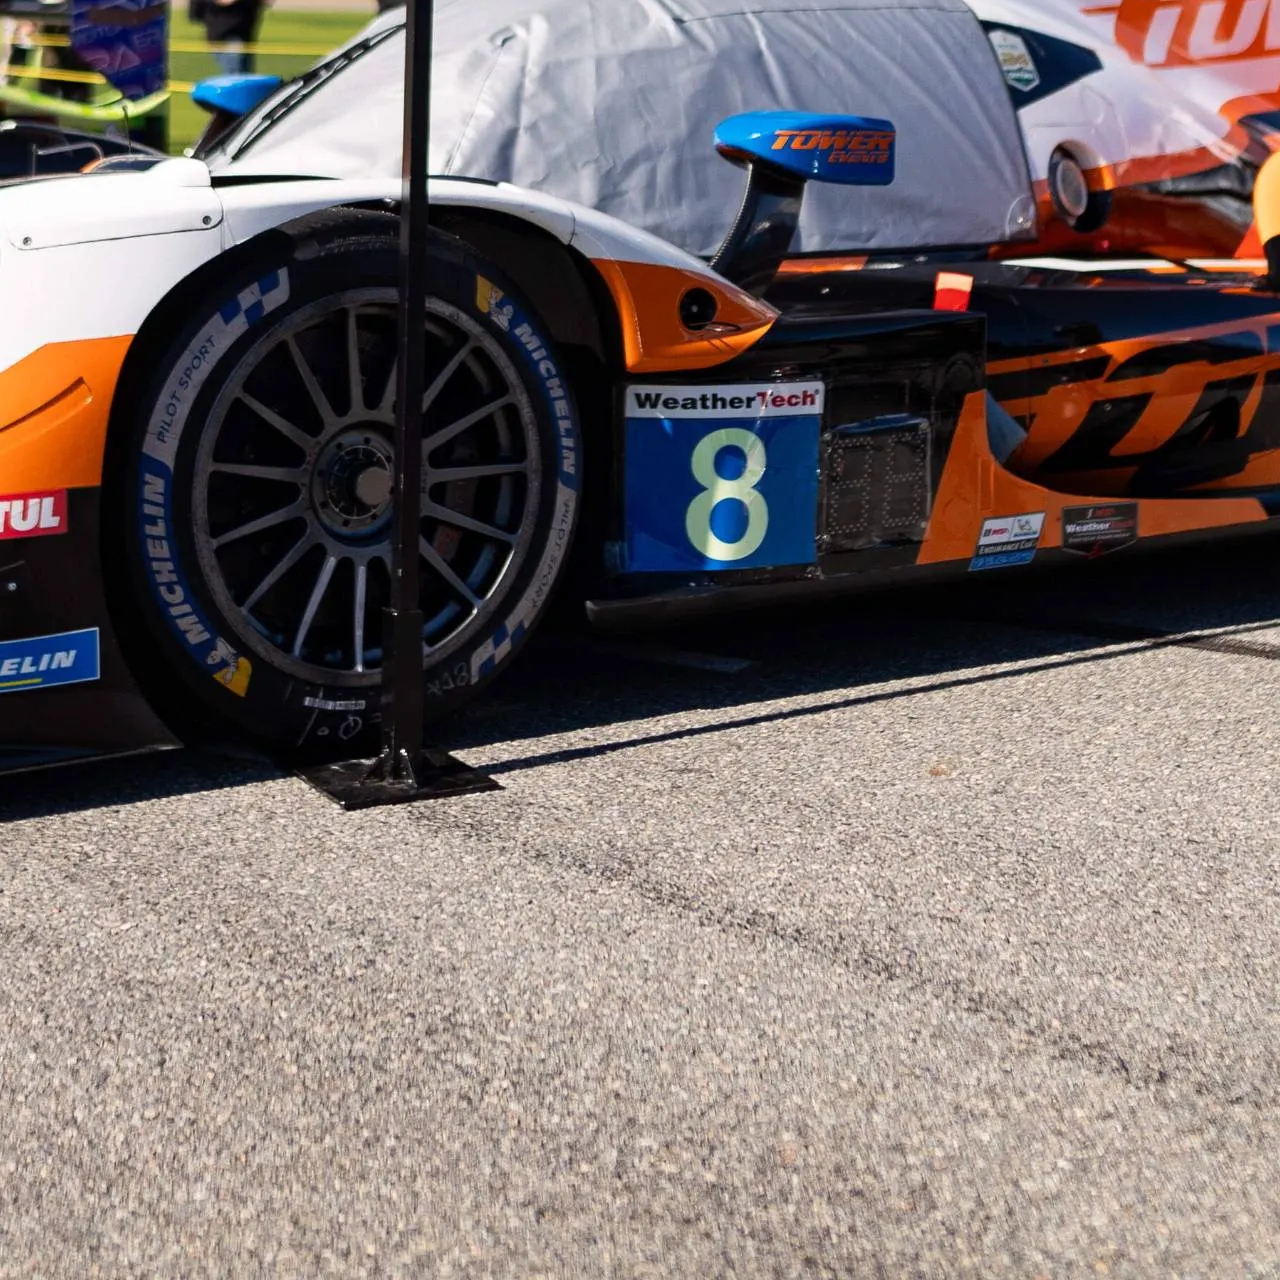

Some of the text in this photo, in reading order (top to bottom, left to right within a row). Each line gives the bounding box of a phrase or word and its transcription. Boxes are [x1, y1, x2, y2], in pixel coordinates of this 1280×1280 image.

[771, 130, 897, 151] TOWER
[156, 333, 217, 445] PILOT SPORT
[514, 322, 577, 475] MICHELIN
[634, 389, 820, 411] WeatherTech
[685, 427, 770, 562] 8
[142, 473, 212, 646] MICHELIN
